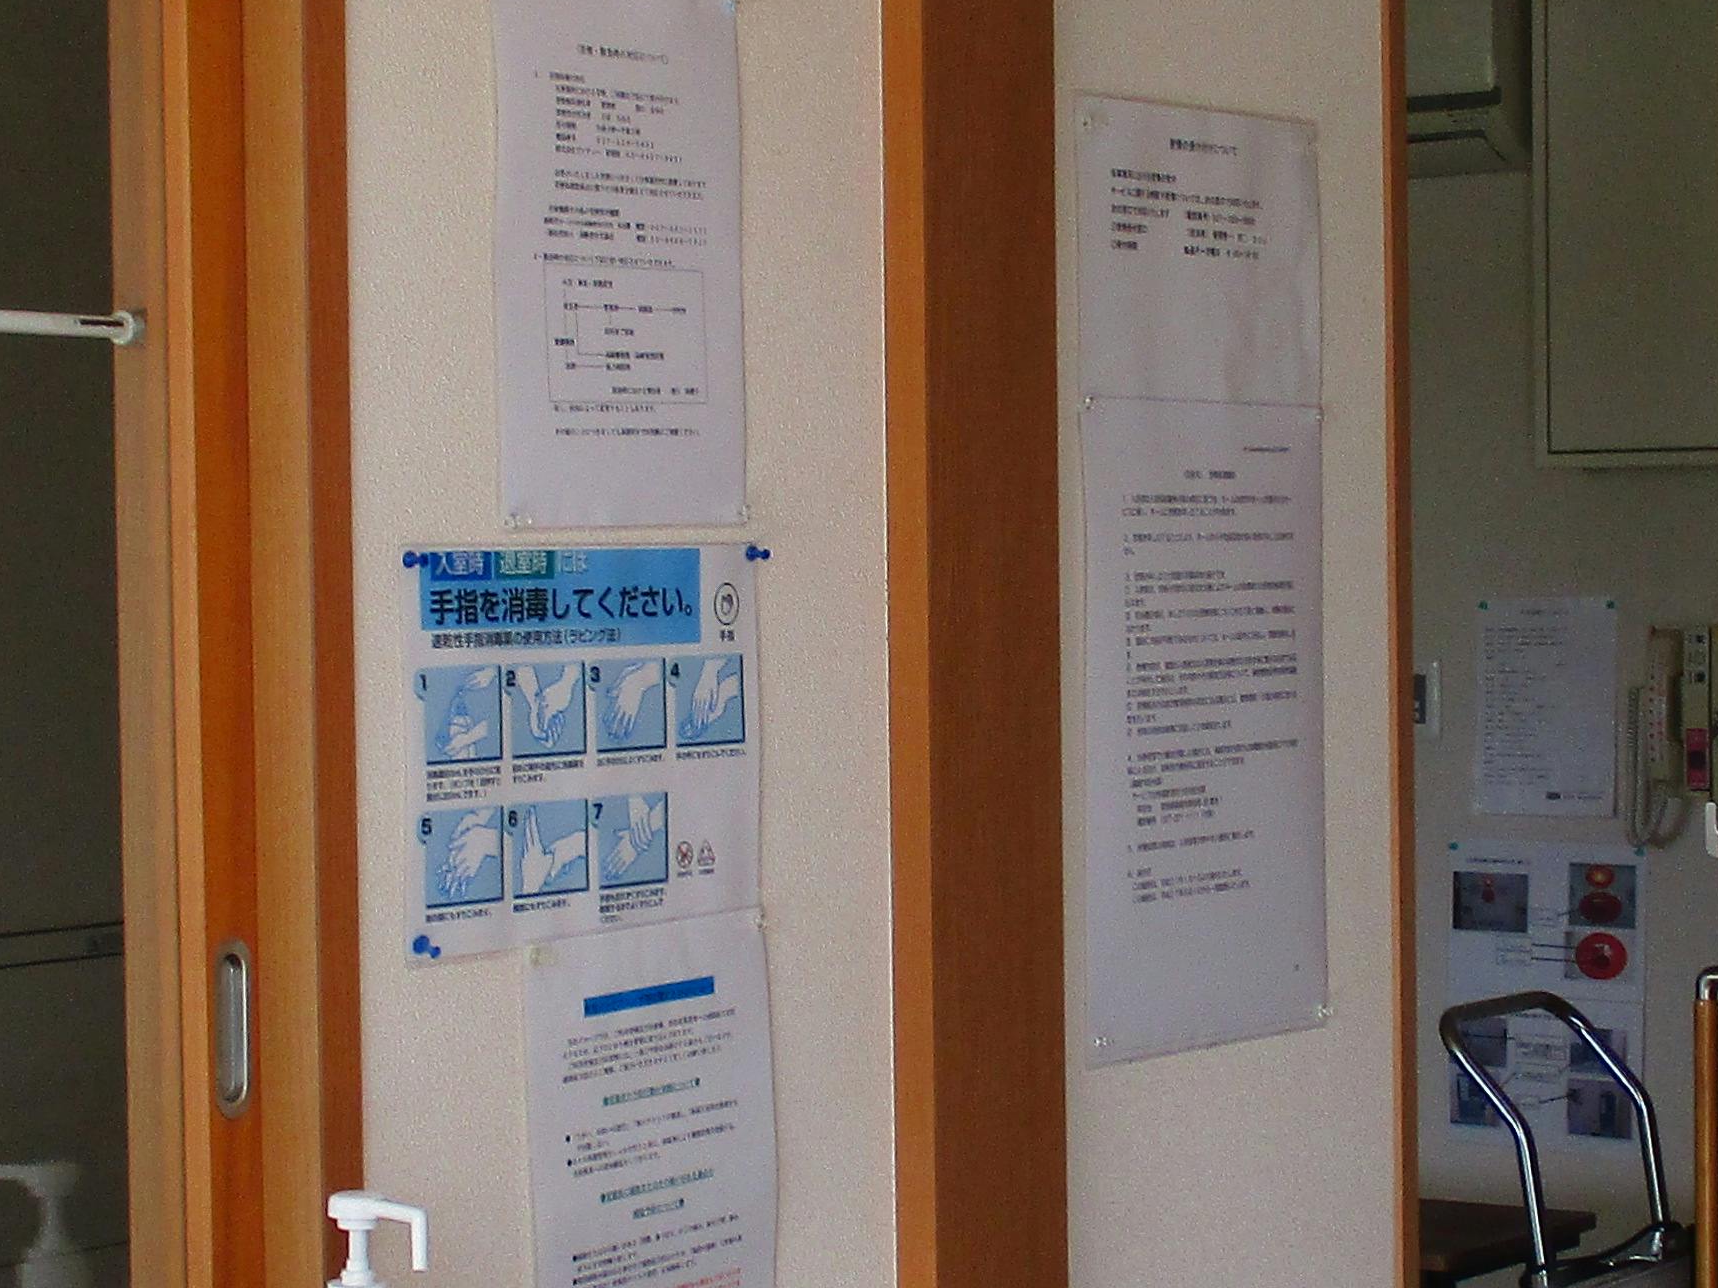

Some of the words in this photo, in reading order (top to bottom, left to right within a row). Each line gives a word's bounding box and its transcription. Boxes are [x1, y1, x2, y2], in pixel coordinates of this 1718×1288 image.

[435, 550, 484, 576] 入室時
[429, 585, 693, 625] 手指を消毒してください。
[505, 669, 517, 688] 2
[589, 665, 601, 684] 3
[669, 662, 681, 679] 4
[419, 673, 428, 692] 1
[507, 810, 518, 828] 6
[592, 802, 603, 820] 7
[420, 818, 432, 836] 5
